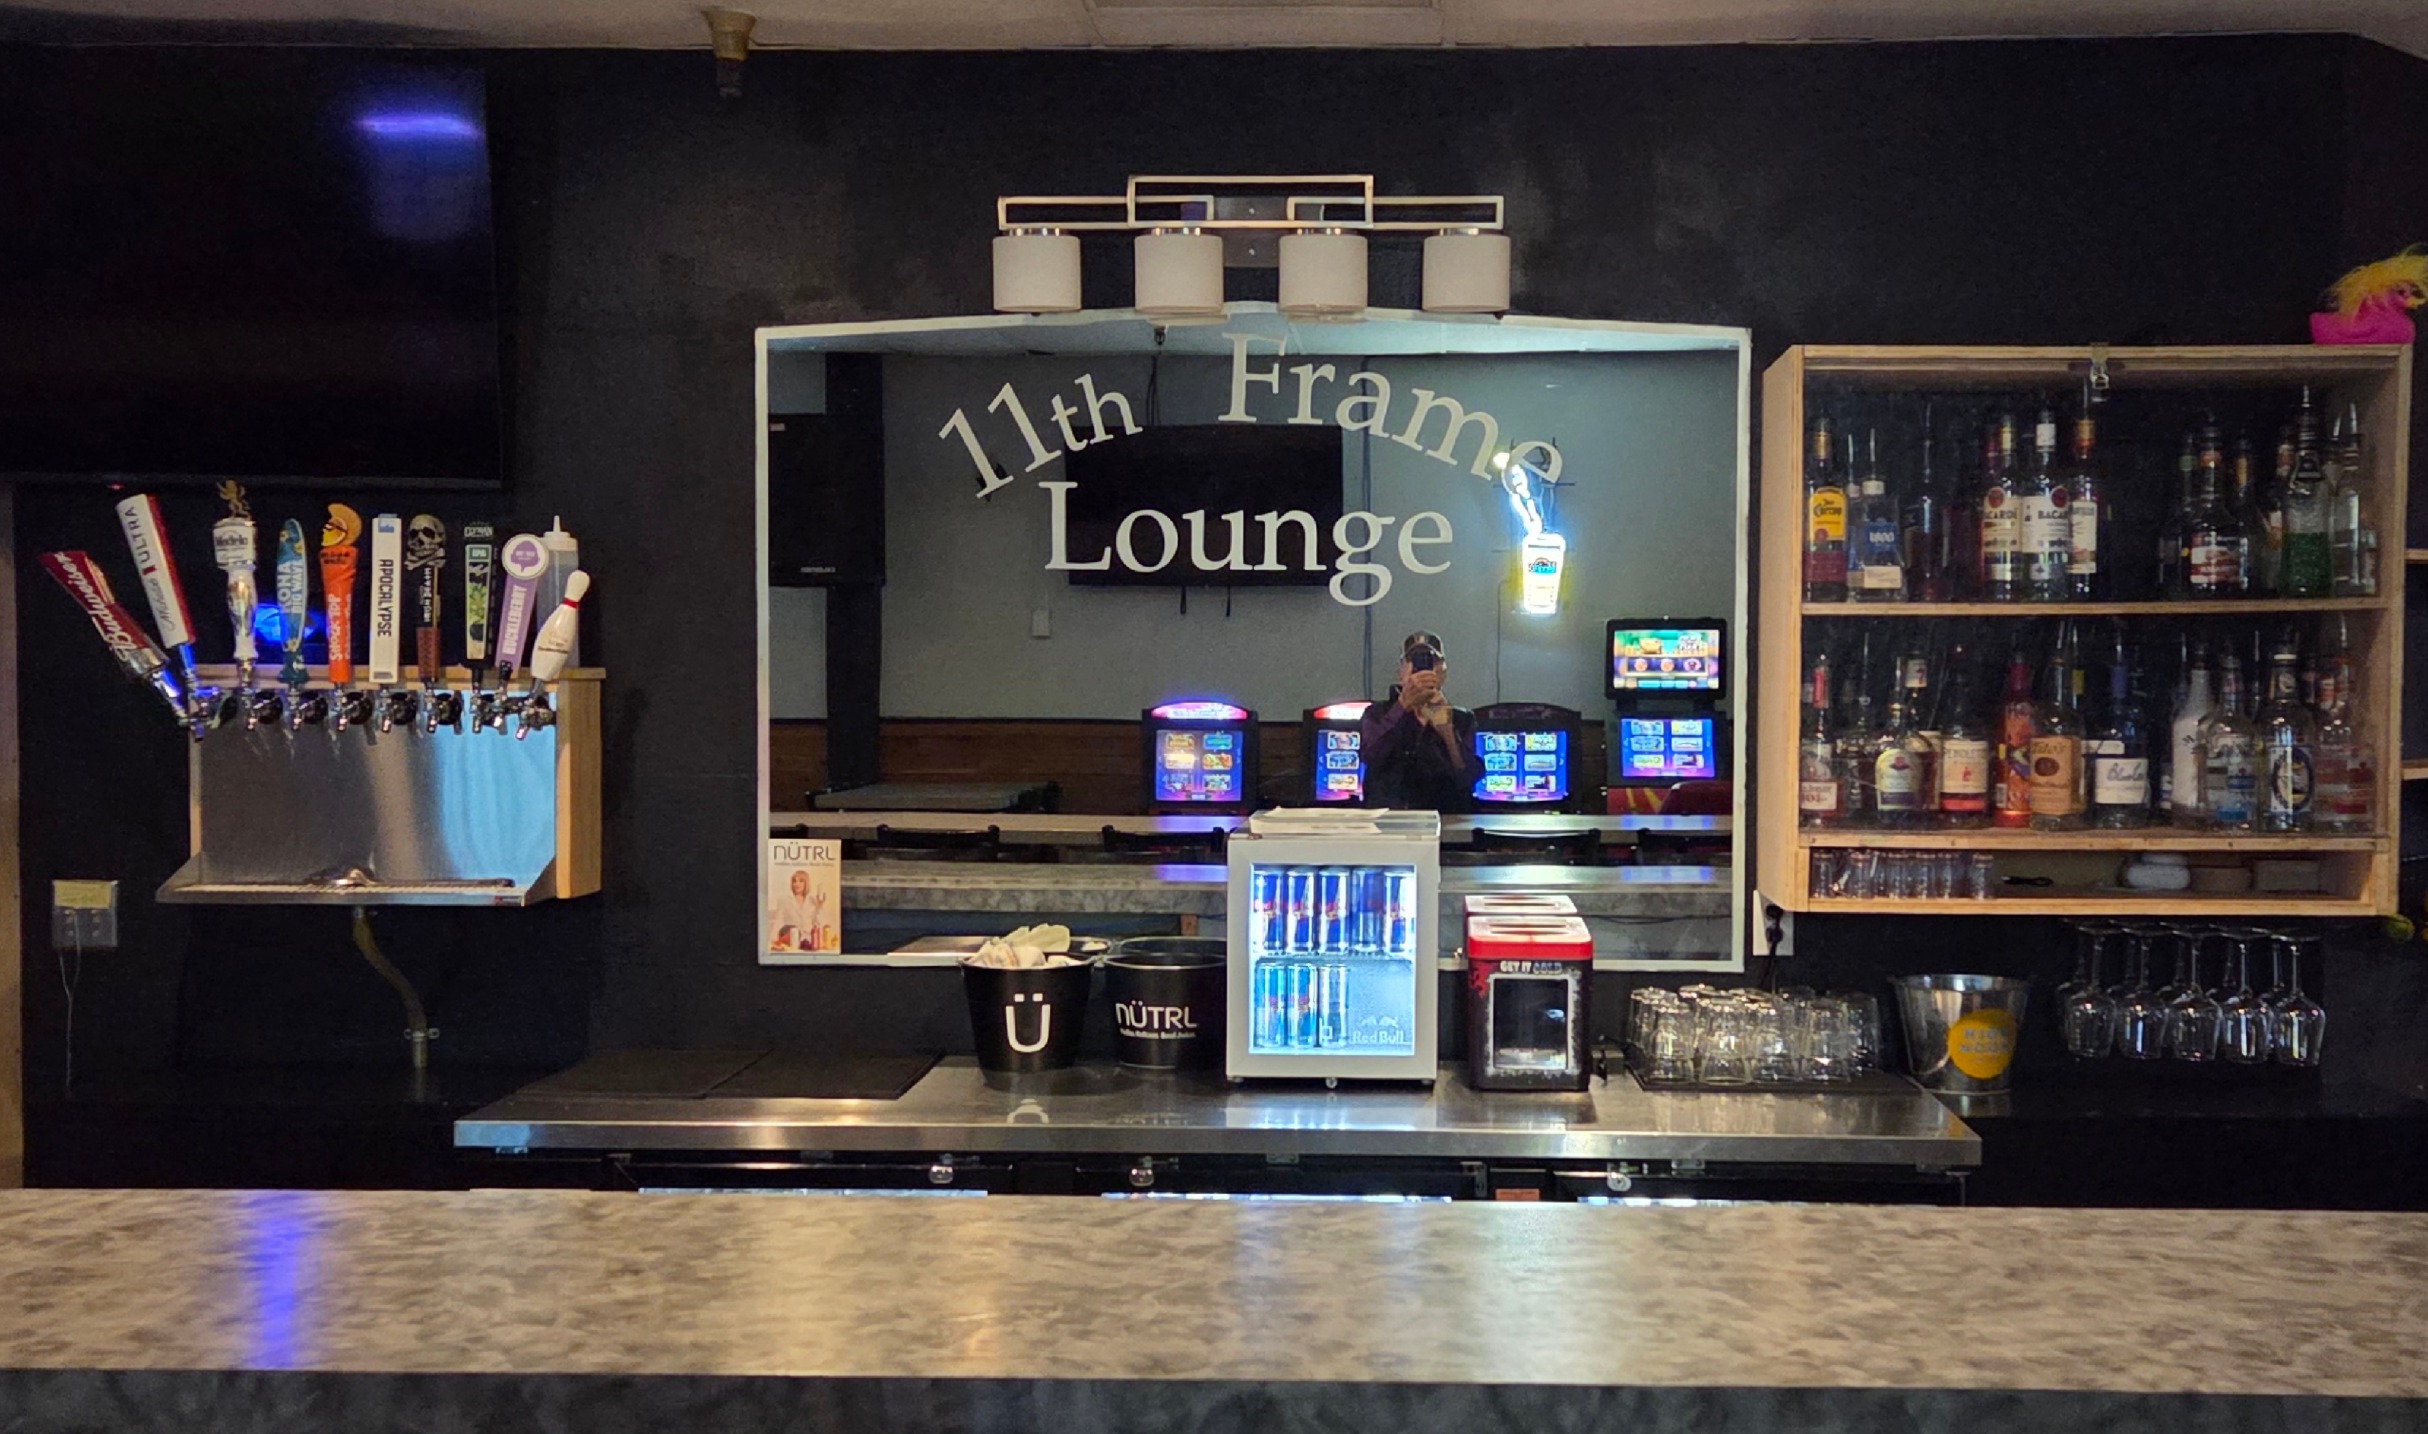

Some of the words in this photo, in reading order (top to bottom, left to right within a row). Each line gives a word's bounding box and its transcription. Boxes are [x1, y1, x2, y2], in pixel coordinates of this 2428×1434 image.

[938, 373, 1142, 500] 11th
[1219, 331, 1565, 487] Frame
[125, 506, 151, 569] ULTRA
[1038, 480, 1454, 607] Lounge
[277, 562, 291, 611] KONA
[291, 559, 302, 592] WAVE
[377, 559, 394, 637] APOCALYPSE
[54, 551, 137, 662] Budweiser
[327, 593, 341, 620] TOP
[328, 620, 342, 662] SHOCK
[1500, 960, 1520, 973] GET
[1521, 960, 1532, 973] IT
[1533, 961, 1562, 975] COLD
[1004, 993, 1051, 1054] Ü
[1350, 1030, 1377, 1045] Red
[1378, 1030, 1408, 1045] Bull
